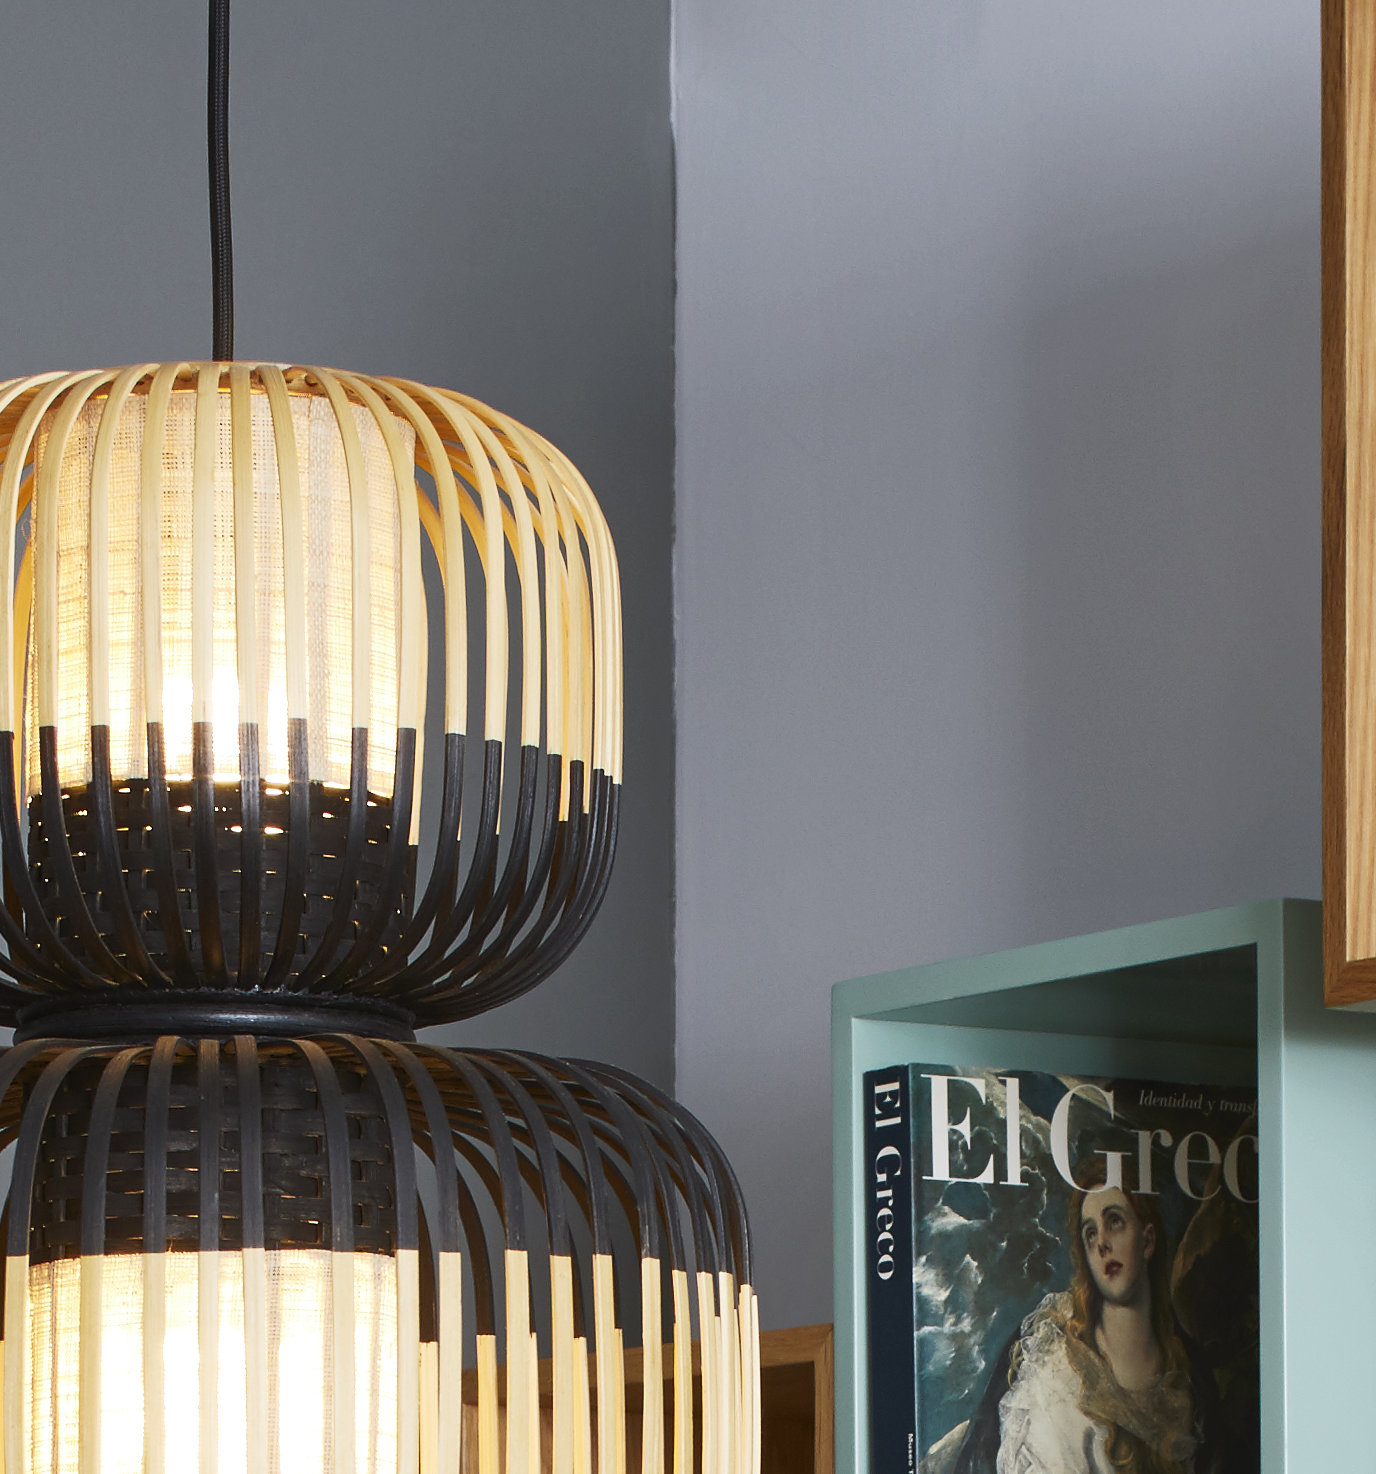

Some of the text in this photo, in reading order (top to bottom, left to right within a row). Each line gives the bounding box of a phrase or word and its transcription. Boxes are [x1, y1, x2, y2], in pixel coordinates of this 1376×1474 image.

[920, 1072, 1029, 1187] El
[1138, 1088, 1215, 1116] Identidad y
[873, 1081, 903, 1281] El Greco
